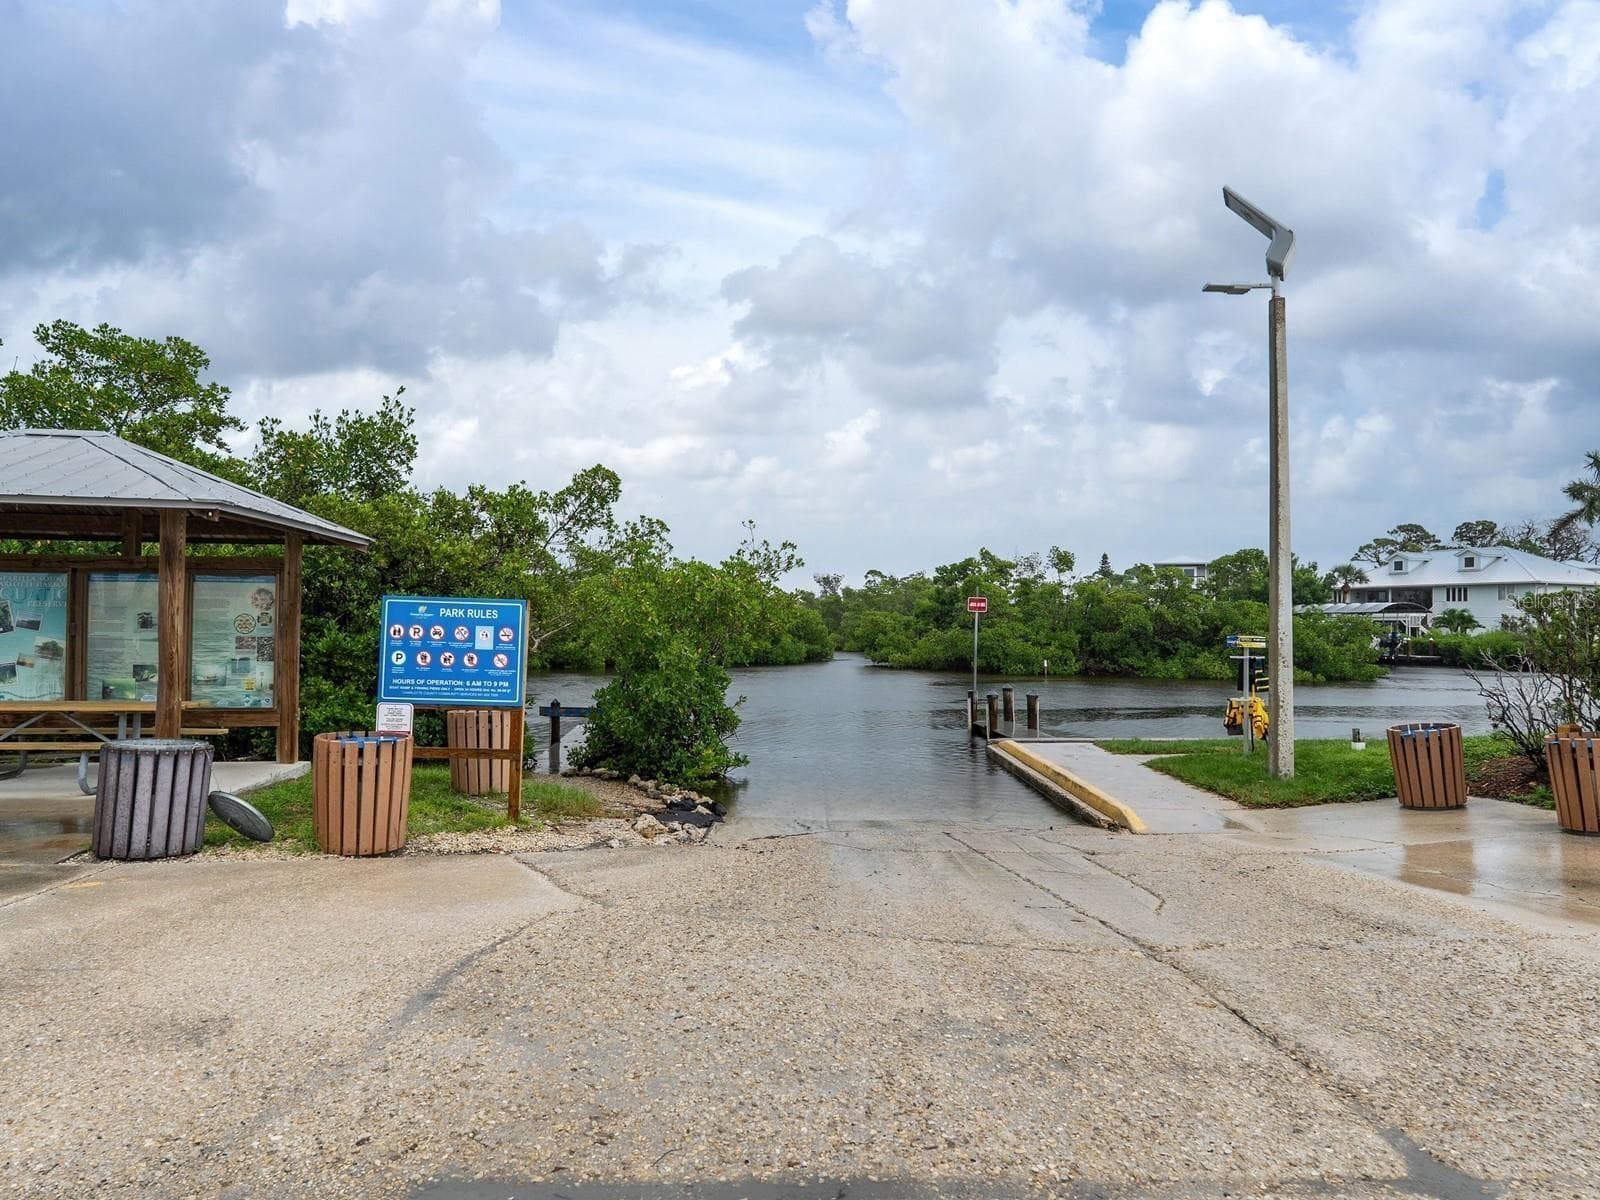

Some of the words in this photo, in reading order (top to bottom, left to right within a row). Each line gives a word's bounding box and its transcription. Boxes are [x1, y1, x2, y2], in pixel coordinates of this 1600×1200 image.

[0, 586, 65, 601] QUATIC
[439, 607, 465, 618] PARK
[467, 608, 498, 619] RULES
